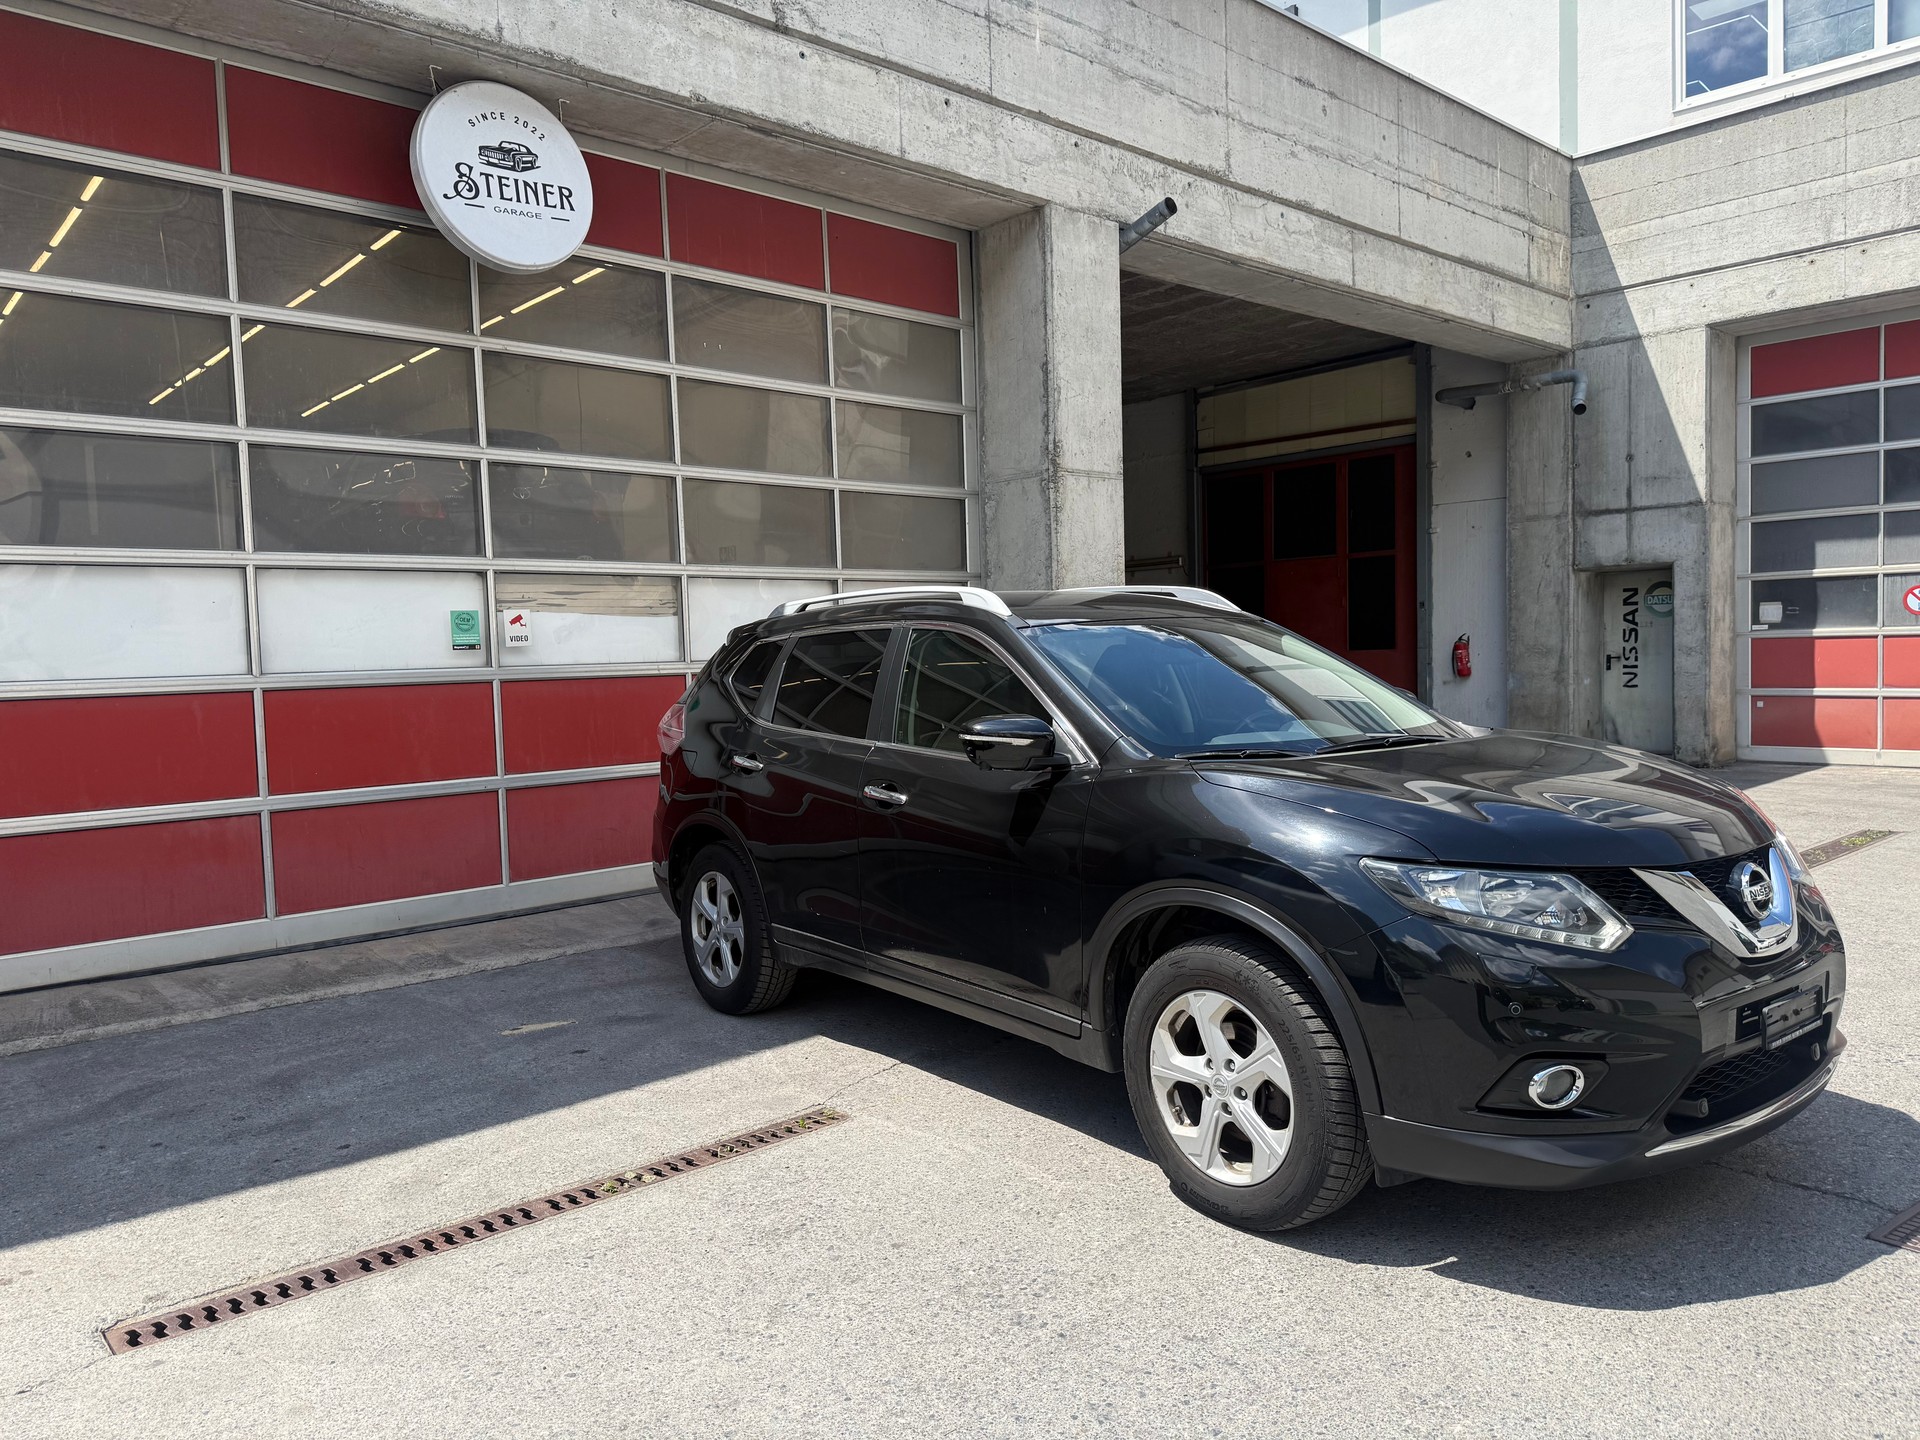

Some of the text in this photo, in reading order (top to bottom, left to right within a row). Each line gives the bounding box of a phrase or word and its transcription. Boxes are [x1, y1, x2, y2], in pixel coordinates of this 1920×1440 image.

[468, 112, 545, 141] SINCE 2022
[443, 162, 576, 212] STEINER
[493, 205, 542, 220] GARAGE
[1647, 595, 1673, 605] DATSU
[509, 634, 529, 643] VIDEO
[1622, 587, 1639, 688] NISSAN
